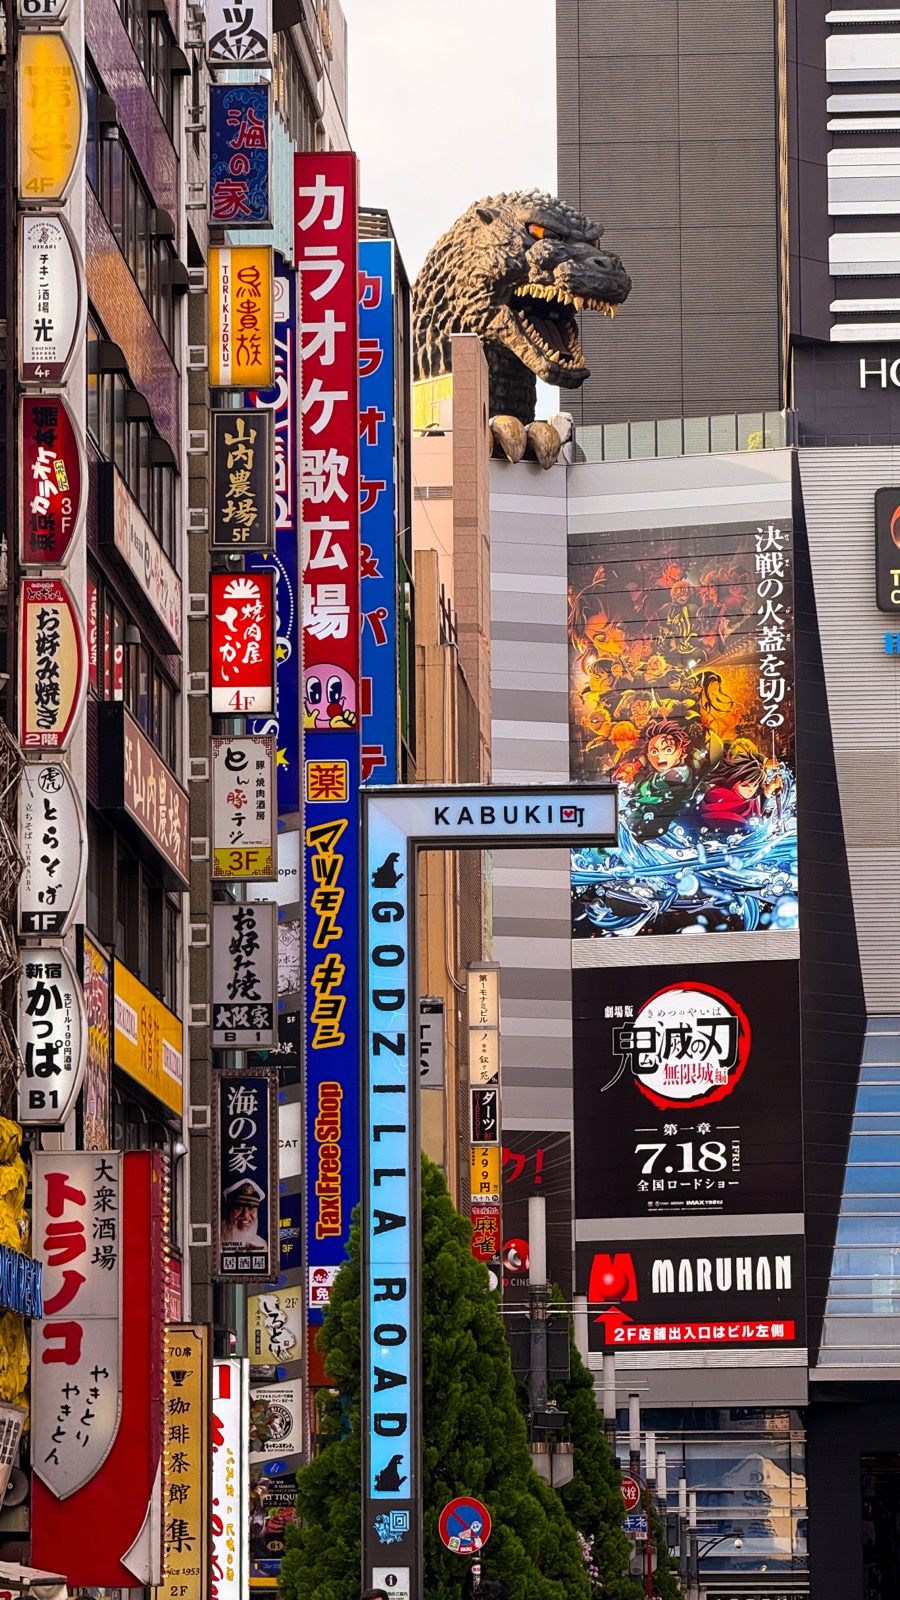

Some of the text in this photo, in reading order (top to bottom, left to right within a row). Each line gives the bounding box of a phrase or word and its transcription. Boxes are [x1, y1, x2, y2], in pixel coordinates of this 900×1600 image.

[211, 108, 267, 219] 海の家
[25, 177, 54, 193] 4F
[38, 254, 50, 313] チキン酒場
[33, 318, 54, 341] 光
[221, 265, 229, 363] TORIKIZOKU
[34, 365, 51, 378] 4F
[297, 174, 350, 640] カラオケ歌広場
[221, 417, 258, 527] 山内農場
[232, 530, 250, 542] 5F
[215, 606, 242, 682] さかい
[240, 599, 266, 665] 焼肉屋
[754, 526, 786, 729] 決戦の火蓋を切る
[35, 607, 61, 729] お好み焼き
[228, 690, 256, 710] 4F
[25, 734, 58, 746] 2階
[39, 767, 62, 791] 虎
[310, 765, 345, 799] 薬
[133, 738, 181, 867] 山内農場
[24, 803, 33, 840] 立ちそば
[38, 798, 62, 905] とらそば
[228, 851, 259, 871] 3F
[30, 914, 57, 930] 1F
[227, 906, 262, 1001] お好み焼
[25, 963, 62, 979] 新宿
[216, 1005, 270, 1029] 大阪家
[286, 1016, 296, 1024] 5F
[604, 1005, 634, 1018] 劇場版
[647, 1006, 722, 1017] きめつのやいば
[25, 982, 64, 1079] かっぱ
[600, 1016, 738, 1092] 鬼滅の刃
[663, 1063, 729, 1086] 無限城編
[28, 1090, 59, 1109] B1
[482, 1091, 496, 1131] ダーツ
[227, 1086, 259, 1174] 海の家
[484, 1132, 494, 1140] 8F
[663, 1122, 712, 1137] 第一章
[314, 1082, 343, 1241] Tax Free Shop
[372, 901, 407, 1437] GODZILLA ROAD
[634, 1141, 727, 1175] 7.18
[637, 1177, 740, 1192] 全国ロードショー
[91, 1159, 118, 1271] 大衆酒場
[282, 1244, 294, 1253] 3F
[474, 1217, 498, 1255] 麻雀
[43, 1172, 87, 1366] トラノコ
[651, 1255, 792, 1294] MARUHAN
[285, 1298, 298, 1308] 2F
[613, 1323, 785, 1342] 2F店舗出入口はビル左側
[168, 1347, 192, 1357] 70席
[76, 1365, 109, 1447] やきとり
[44, 1382, 81, 1465] やきとん
[168, 1398, 191, 1504] 珈琲茶館
[165, 1518, 196, 1553] 集
[182, 1566, 200, 1577] 1953
[171, 1586, 188, 1598] 2F
